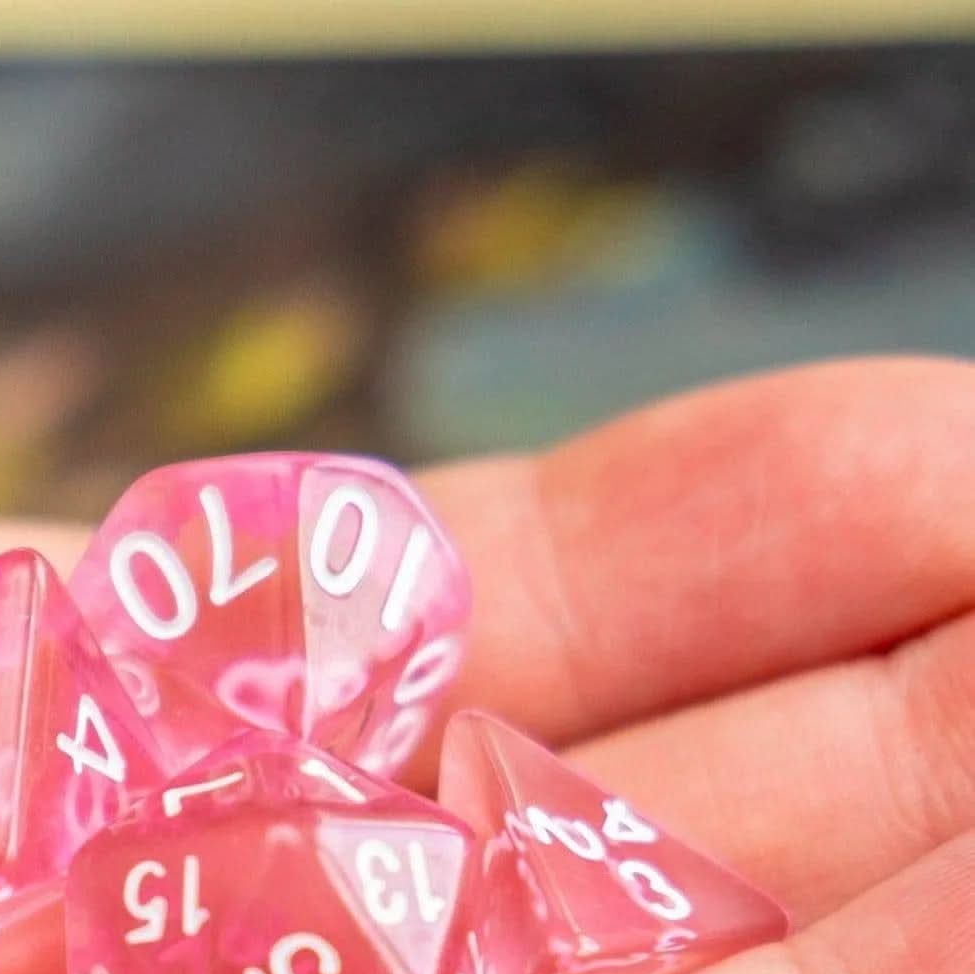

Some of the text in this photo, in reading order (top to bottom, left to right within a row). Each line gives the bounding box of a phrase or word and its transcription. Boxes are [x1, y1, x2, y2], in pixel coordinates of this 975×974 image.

[110, 485, 279, 640] 70
[310, 485, 430, 633] 10
[56, 693, 126, 784] 4
[123, 854, 210, 945] 15
[355, 838, 445, 925] 13
